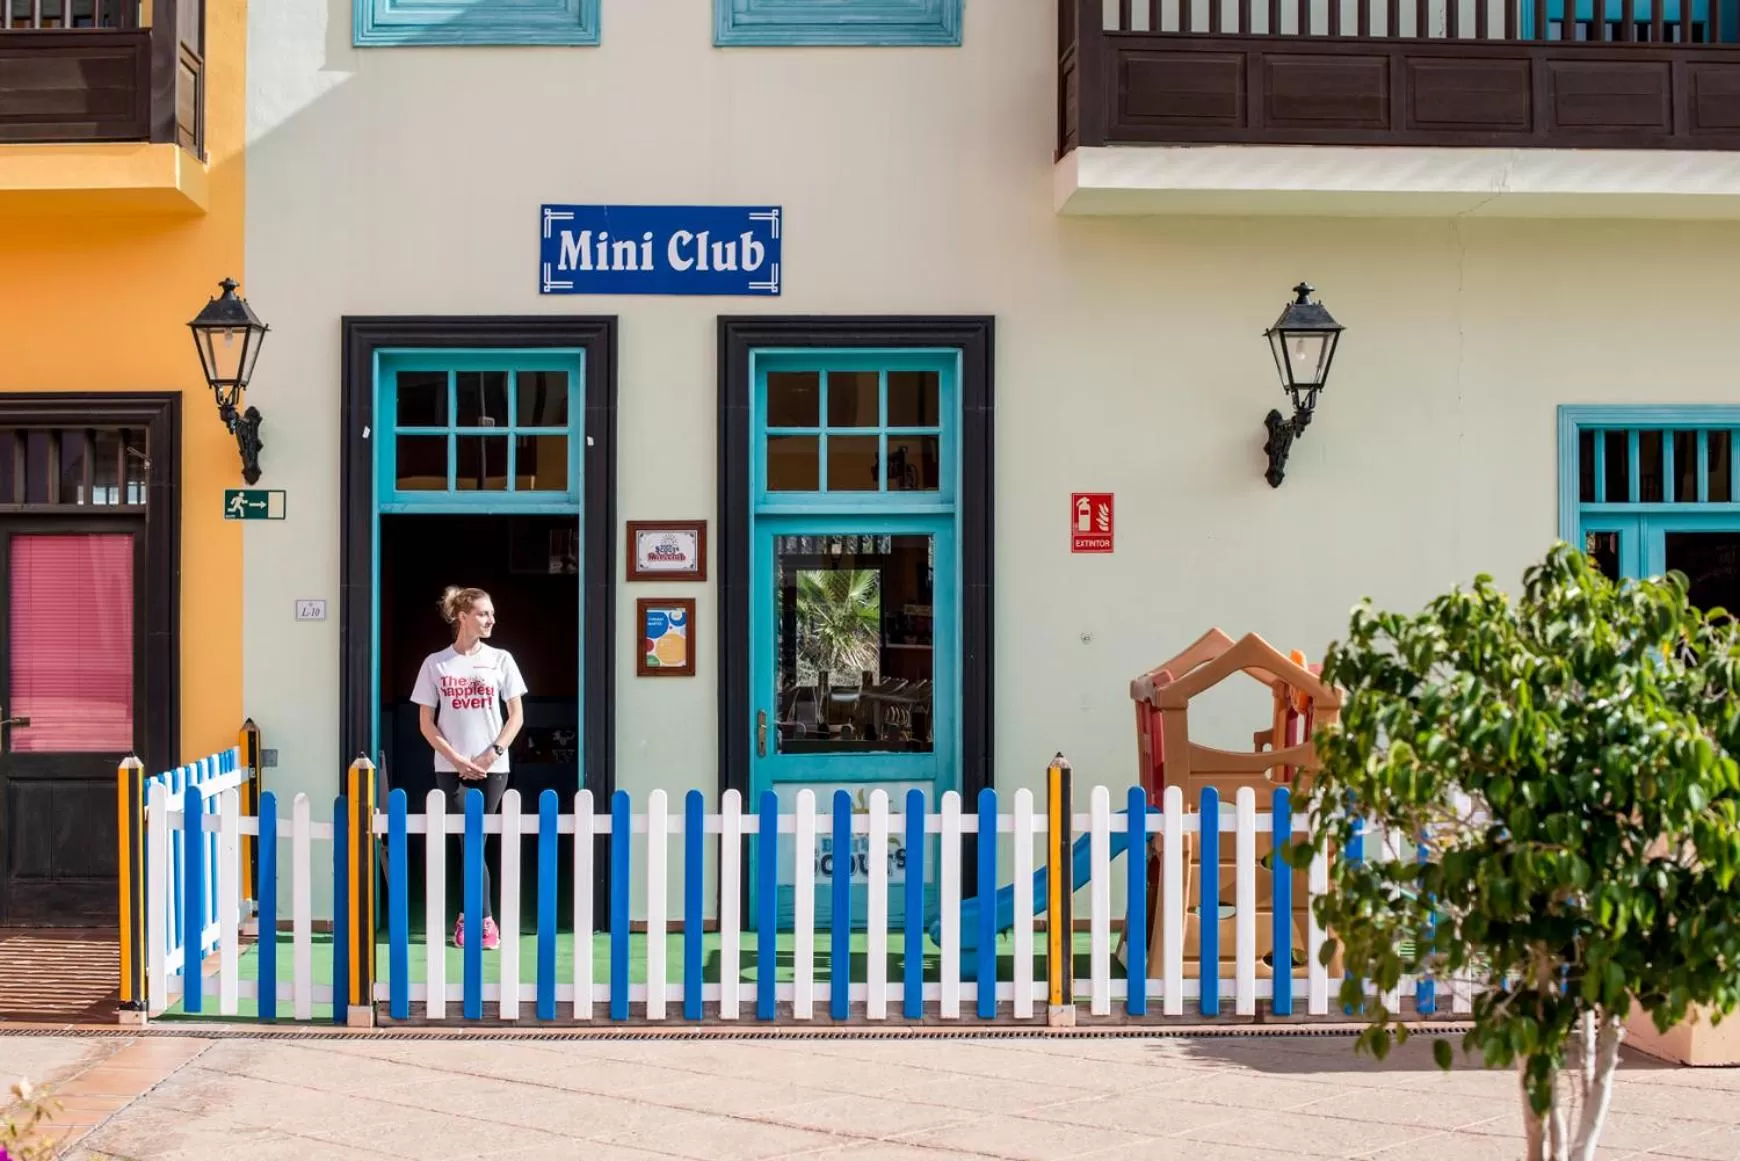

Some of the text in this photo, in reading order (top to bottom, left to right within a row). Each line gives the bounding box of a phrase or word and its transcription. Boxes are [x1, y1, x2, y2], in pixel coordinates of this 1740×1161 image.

[557, 230, 765, 272] Mini Club
[1075, 539, 1110, 547] EXTINTOR
[441, 676, 467, 687] The
[452, 696, 492, 710] ever!
